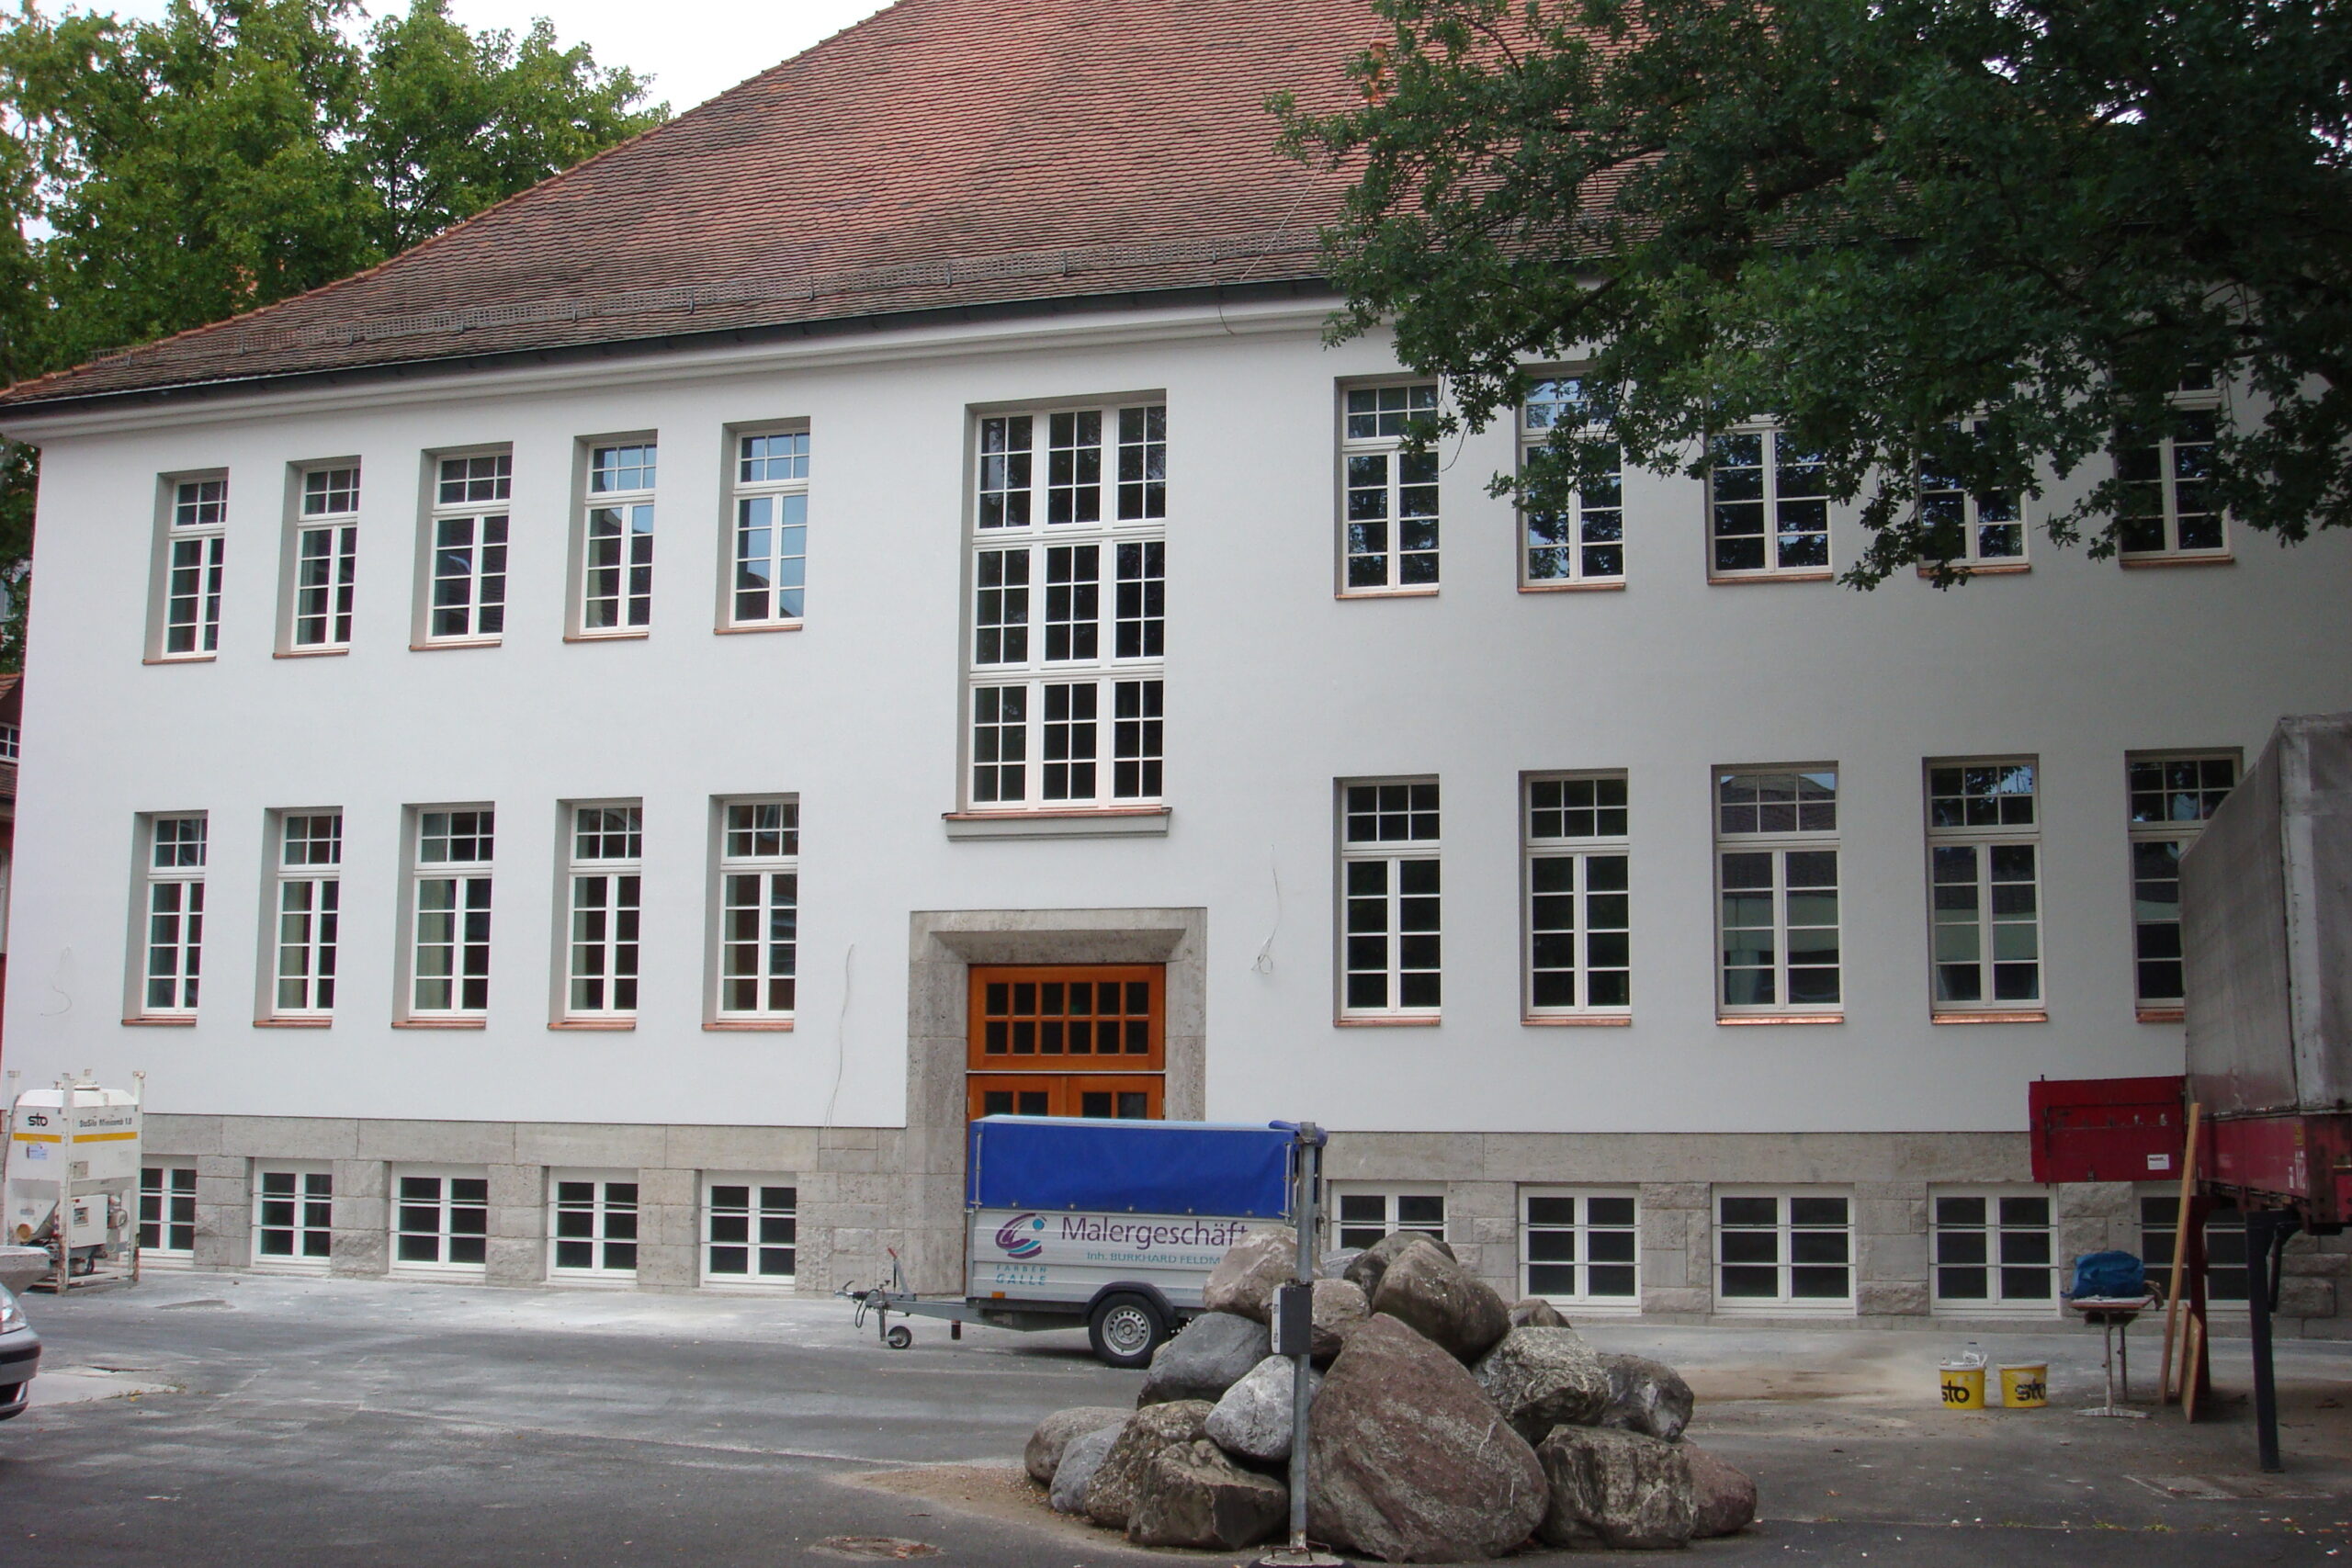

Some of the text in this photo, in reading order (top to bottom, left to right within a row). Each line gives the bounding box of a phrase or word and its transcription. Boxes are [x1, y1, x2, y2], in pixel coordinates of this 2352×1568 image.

[28, 1111, 49, 1127] sto
[1061, 1216, 1249, 1250] Malergeschäft
[1087, 1251, 1221, 1265] Inh. BURKHARD FELDM
[996, 1264, 1046, 1273] FARBEN
[996, 1273, 1046, 1286] GALLE
[1941, 1380, 1970, 1404] sto
[2015, 1379, 2047, 1402] sto
